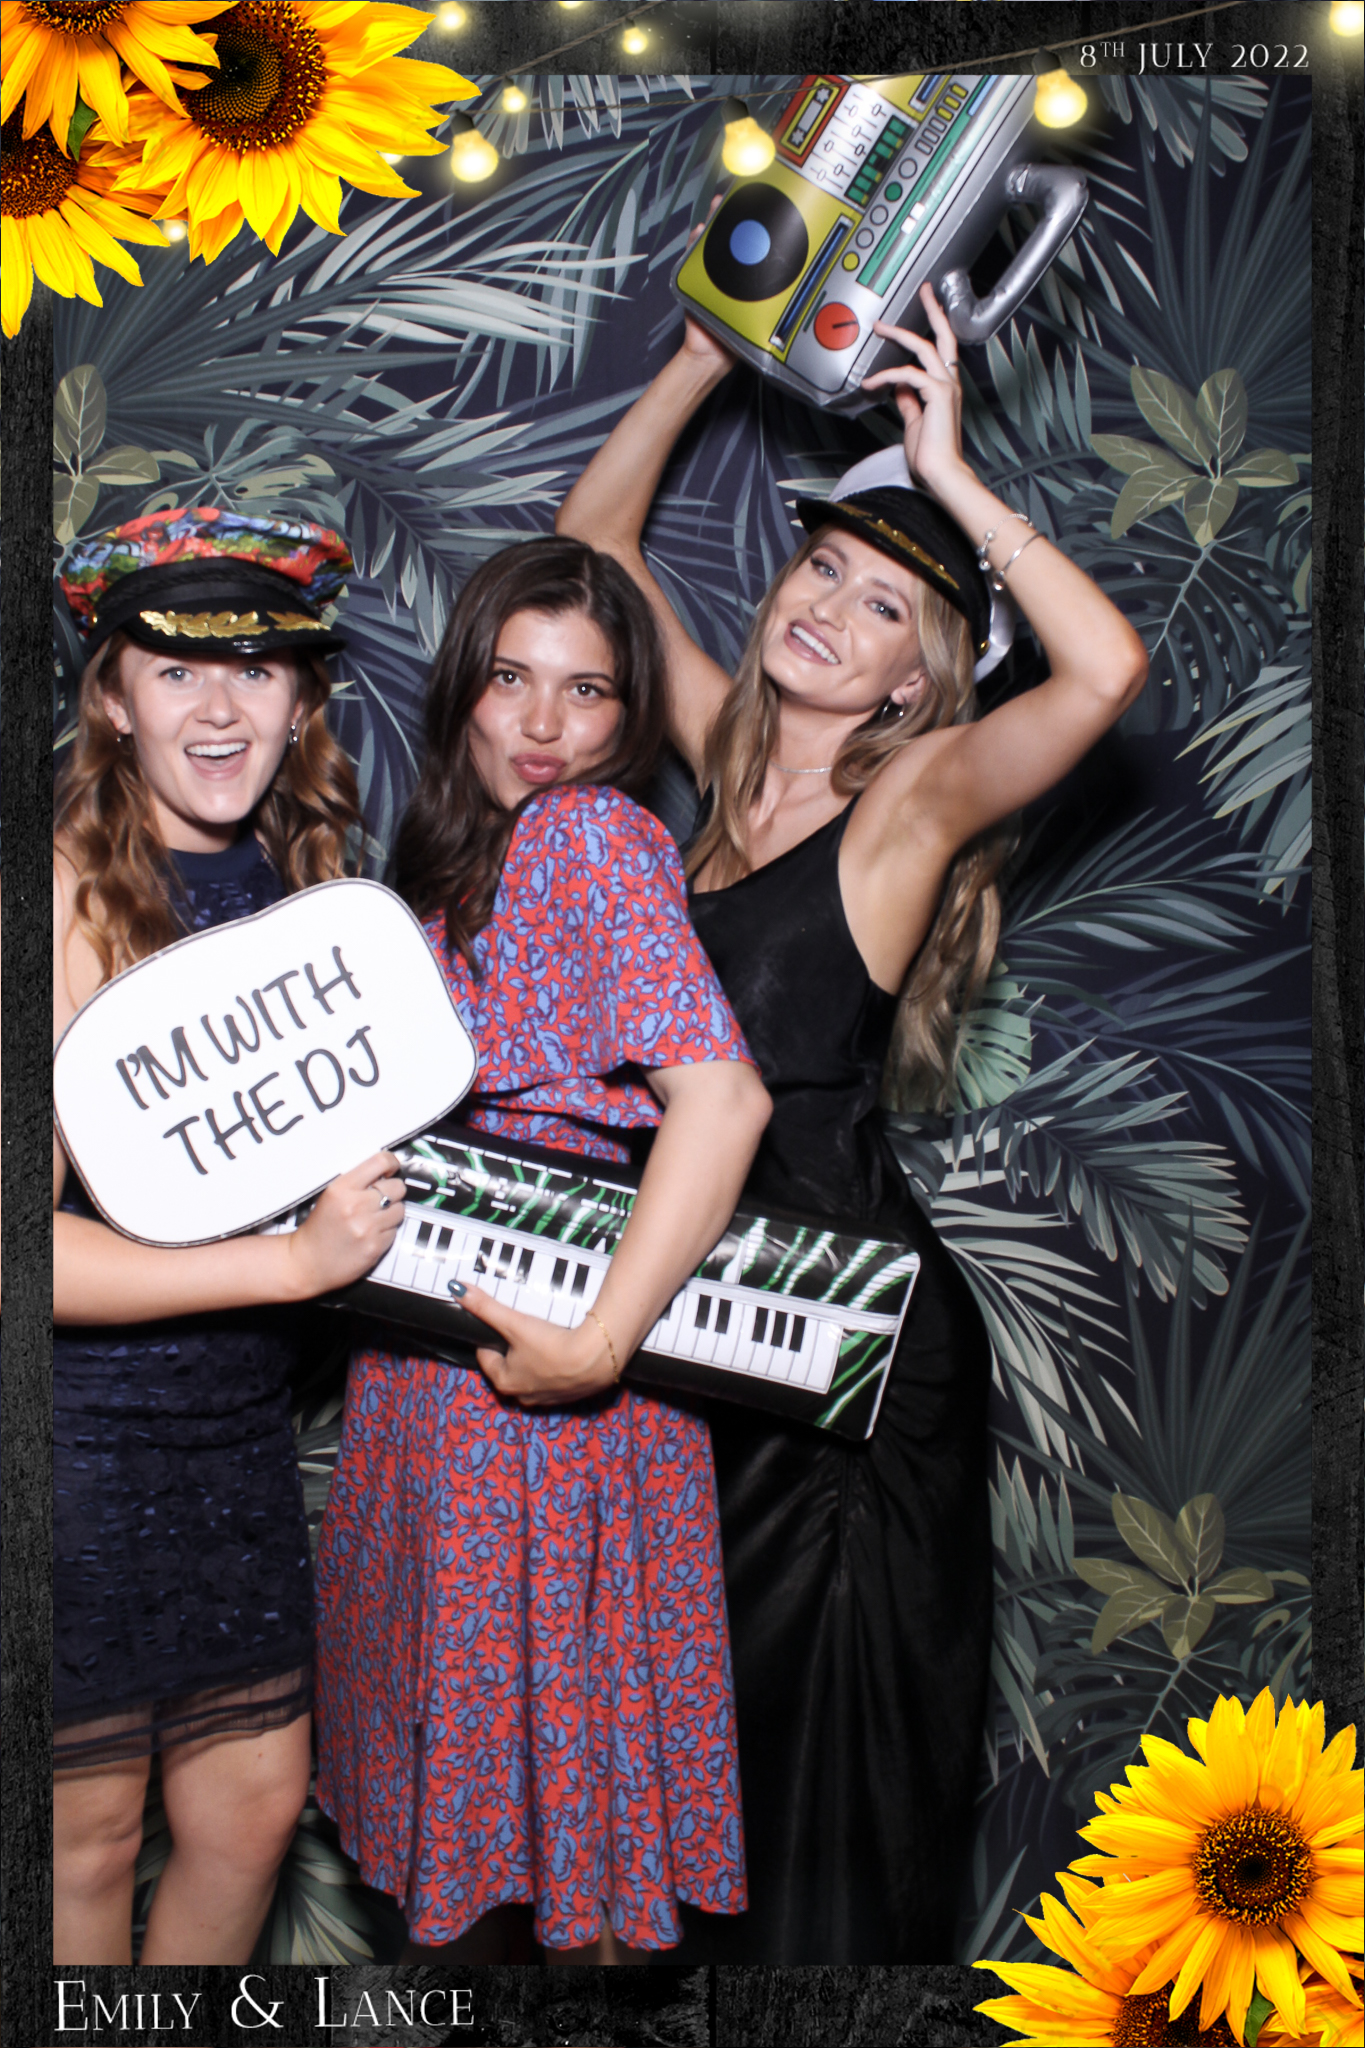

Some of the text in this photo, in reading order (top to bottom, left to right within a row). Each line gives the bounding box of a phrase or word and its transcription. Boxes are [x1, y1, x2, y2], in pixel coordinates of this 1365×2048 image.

[115, 945, 362, 1111] I'M WITH
[163, 1025, 381, 1176] THE DJ
